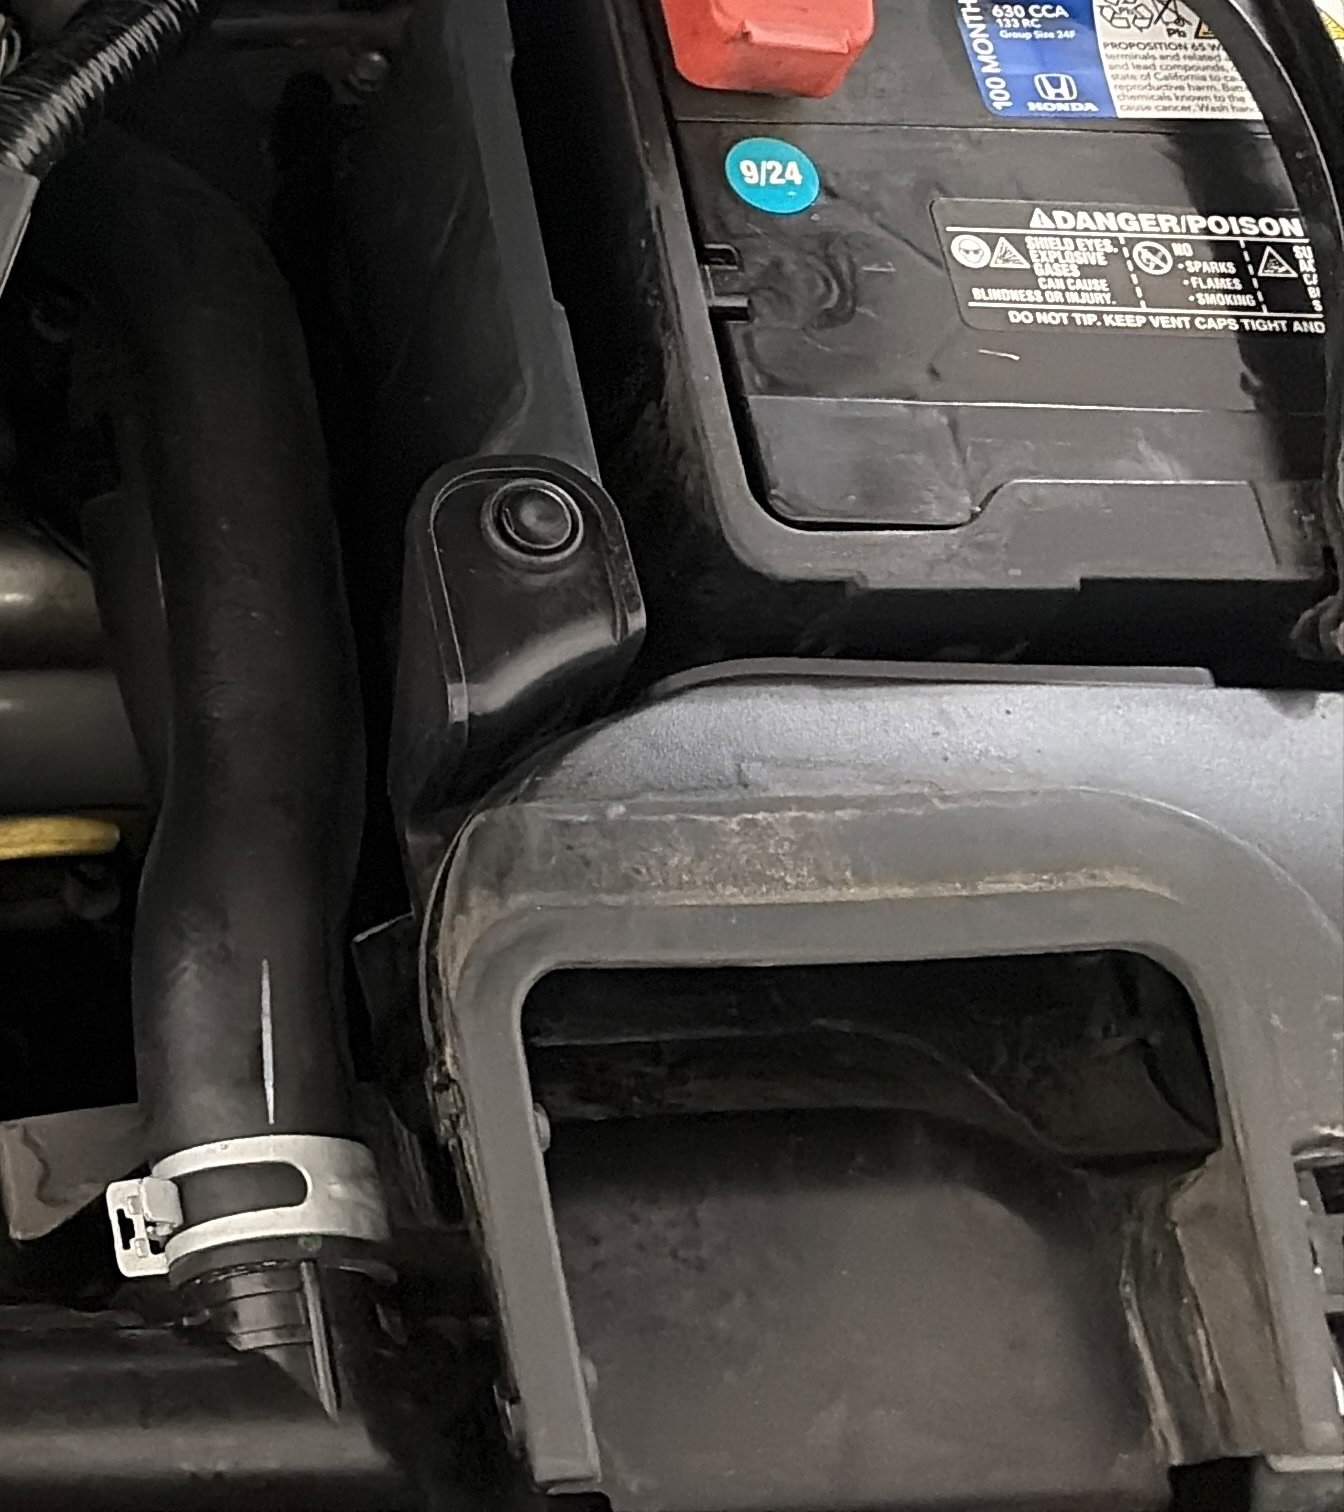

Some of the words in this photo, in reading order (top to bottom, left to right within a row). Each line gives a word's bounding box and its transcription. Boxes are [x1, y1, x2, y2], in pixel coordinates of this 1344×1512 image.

[991, 4, 1026, 19] 630
[1028, 4, 1070, 19] CCA
[996, 19, 1020, 29] 133
[1022, 19, 1042, 29] RC
[999, 30, 1032, 41] Group
[1033, 30, 1055, 39] Size
[1103, 41, 1189, 52] PROPOSITION
[1190, 41, 1206, 52] 65
[1183, 52, 1222, 62] related
[1132, 62, 1157, 71] lead
[1154, 71, 1208, 82] California
[985, 76, 1014, 111] 100
[1025, 101, 1100, 113] HONDA
[739, 159, 803, 187] 9/24
[1052, 210, 1305, 237] DANGER/POISON
[1025, 236, 1075, 251] SHIELD
[1171, 242, 1194, 257] NO
[1029, 249, 1108, 266] EXPLOSIVE
[1033, 263, 1081, 278] GASES
[1185, 260, 1237, 275] SPARKS
[1037, 277, 1065, 291] CAN
[1066, 278, 1110, 292] CAUSE
[1190, 277, 1243, 291] FLAMES
[971, 288, 1043, 303] BLINDNESS
[1045, 290, 1065, 304] OR
[1065, 291, 1117, 306] INJURY.
[1195, 293, 1256, 307] SMOKING
[1008, 310, 1033, 324] DO
[1036, 311, 1069, 325] NOT
[1070, 312, 1102, 326] TIP.
[1103, 313, 1147, 328] KEEP
[1149, 315, 1191, 329] VENT
[1194, 317, 1240, 331] CAPS
[1240, 319, 1288, 333] TIGHT
[1292, 320, 1326, 334] AND
